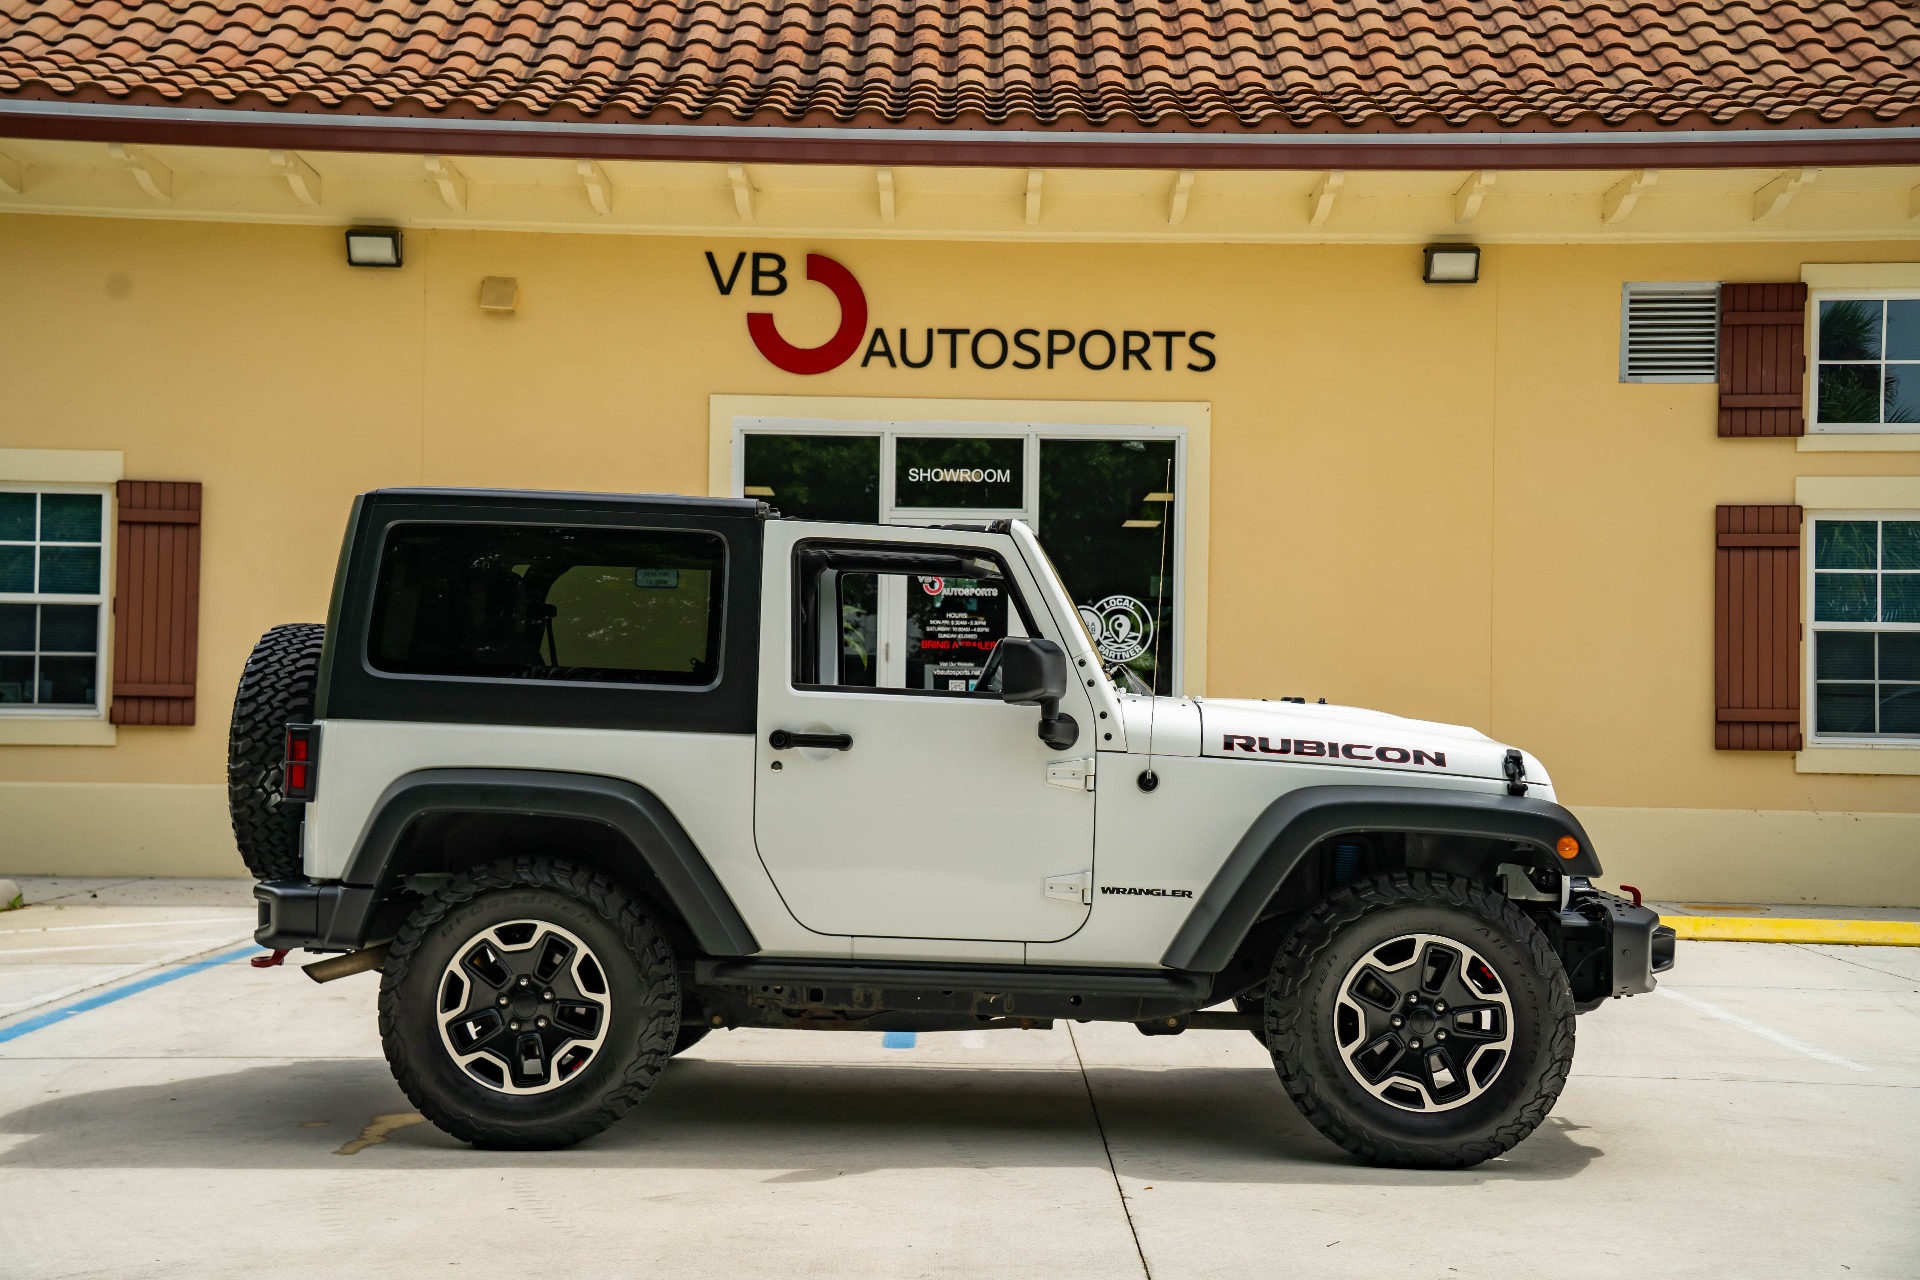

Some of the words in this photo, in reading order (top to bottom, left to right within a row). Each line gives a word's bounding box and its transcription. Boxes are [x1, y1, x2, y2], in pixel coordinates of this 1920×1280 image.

[705, 251, 788, 297] VB
[861, 328, 1217, 372] AUTOSPORTS
[908, 468, 1011, 482] SHOWROOM
[941, 588, 998, 597] AUTOSPORTS
[1103, 598, 1135, 610] LOCAL
[921, 640, 950, 650] BRING
[952, 640, 959, 650] A
[1098, 644, 1143, 660] PARTNER
[1223, 734, 1447, 767] RUBICON
[1100, 886, 1193, 899] WRANGLER
